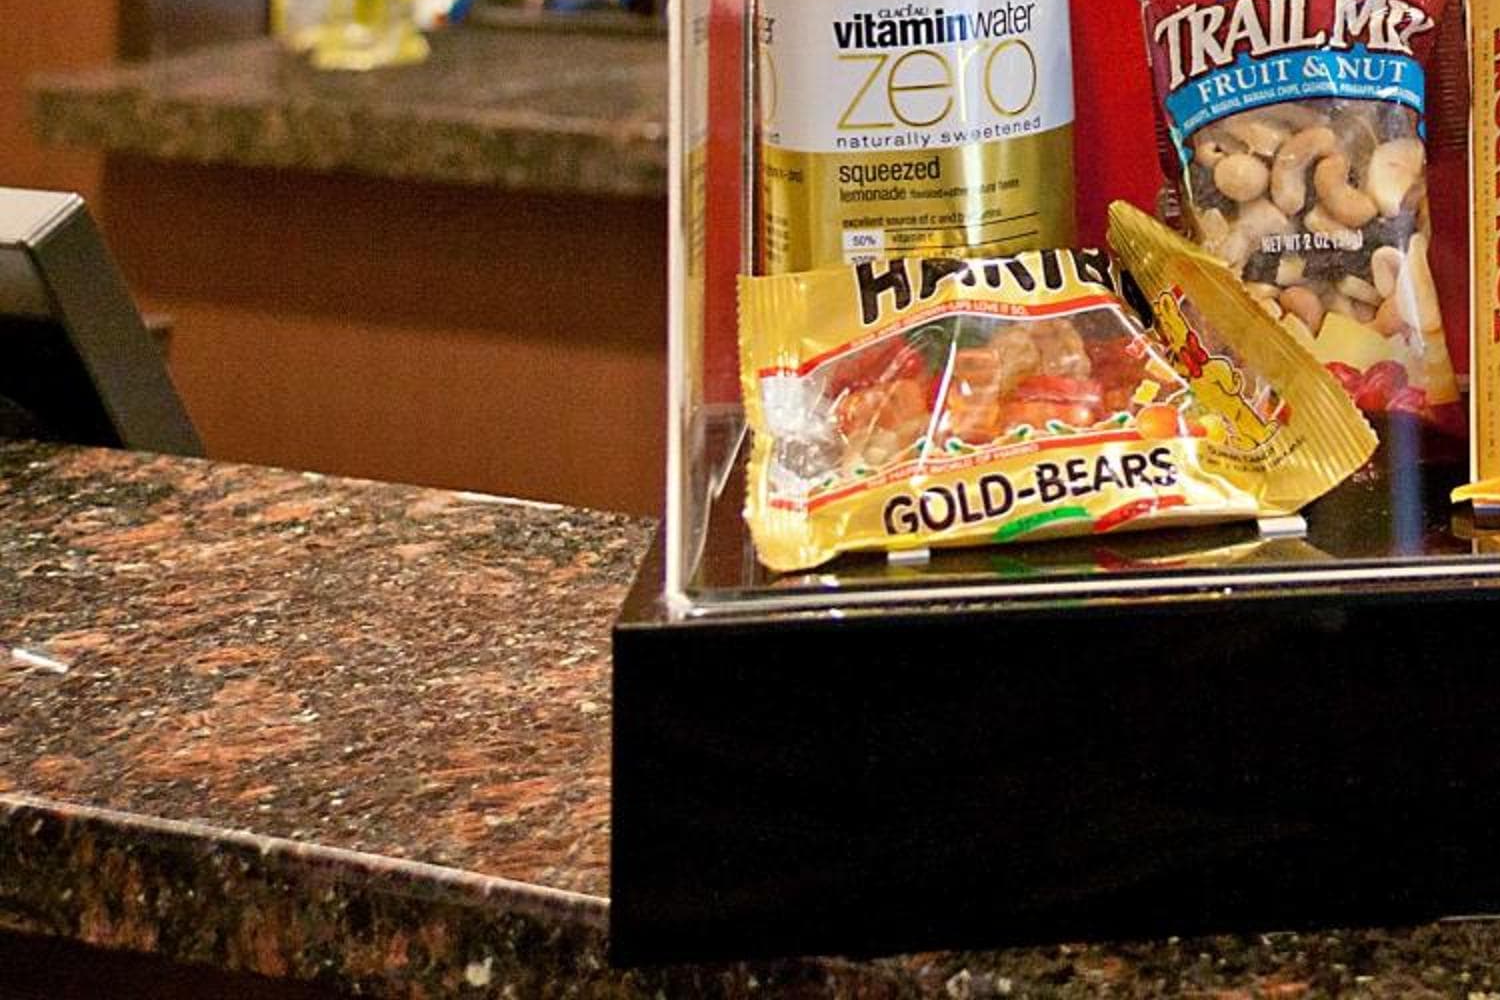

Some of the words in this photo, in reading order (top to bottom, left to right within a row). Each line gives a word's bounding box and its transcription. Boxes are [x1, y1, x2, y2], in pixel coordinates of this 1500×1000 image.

[833, 0, 1036, 49] vitaminwater
[835, 38, 1037, 131] zero
[1197, 56, 1291, 104] FRUIT
[1302, 55, 1330, 79] &
[1336, 56, 1408, 83] NUT
[836, 129, 932, 150] naturally
[940, 115, 1042, 144] sweetened
[838, 155, 942, 186] squeezed
[839, 186, 908, 204] lemonade
[883, 447, 1178, 536] GOLD-BEARS
